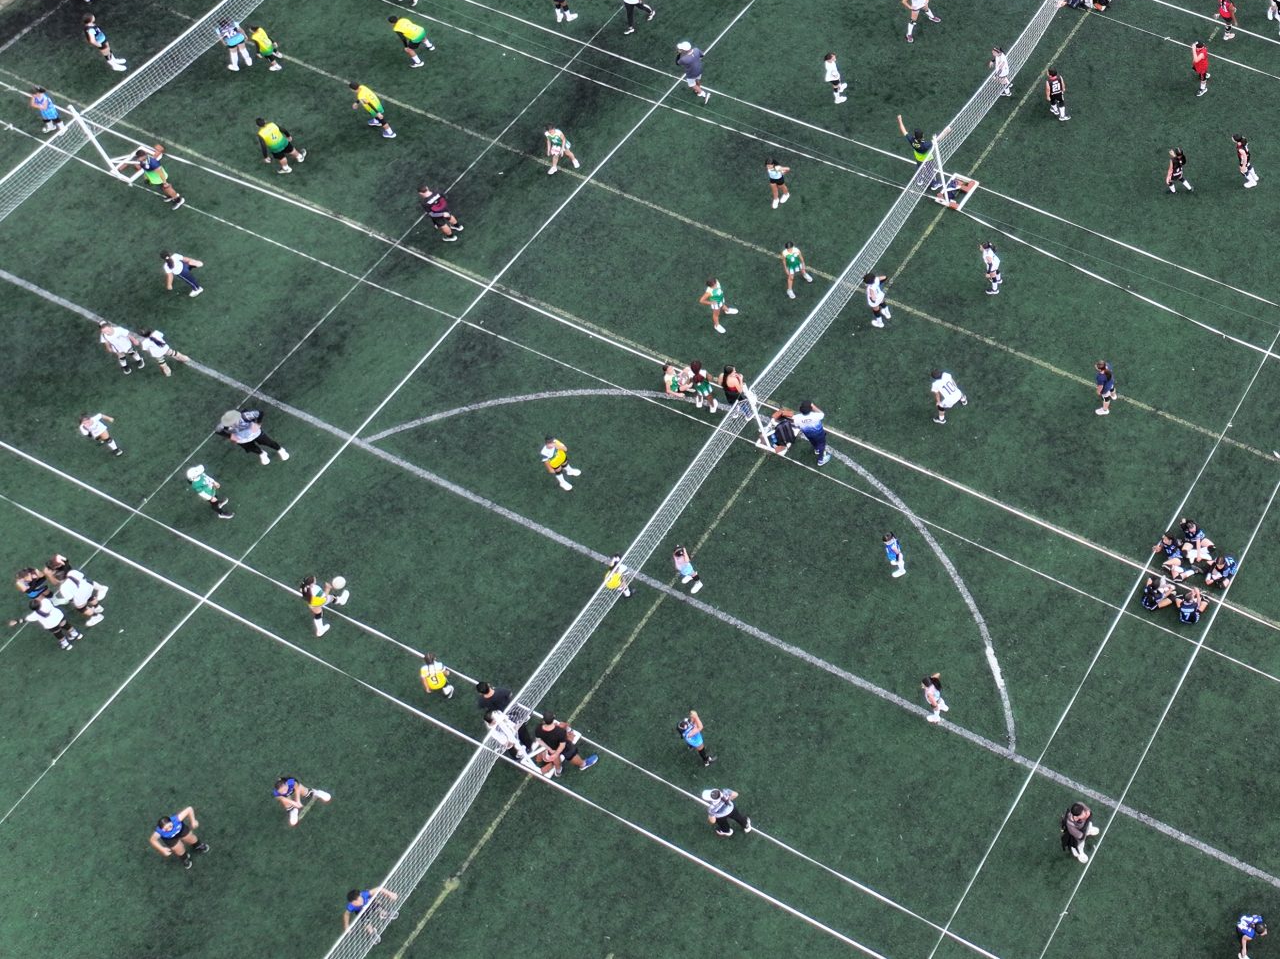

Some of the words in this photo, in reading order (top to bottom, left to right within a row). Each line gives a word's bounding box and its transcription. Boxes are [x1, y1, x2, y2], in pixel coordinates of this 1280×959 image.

[942, 380, 955, 395] 10
[1184, 612, 1191, 621] 7
[431, 675, 439, 685] 9
